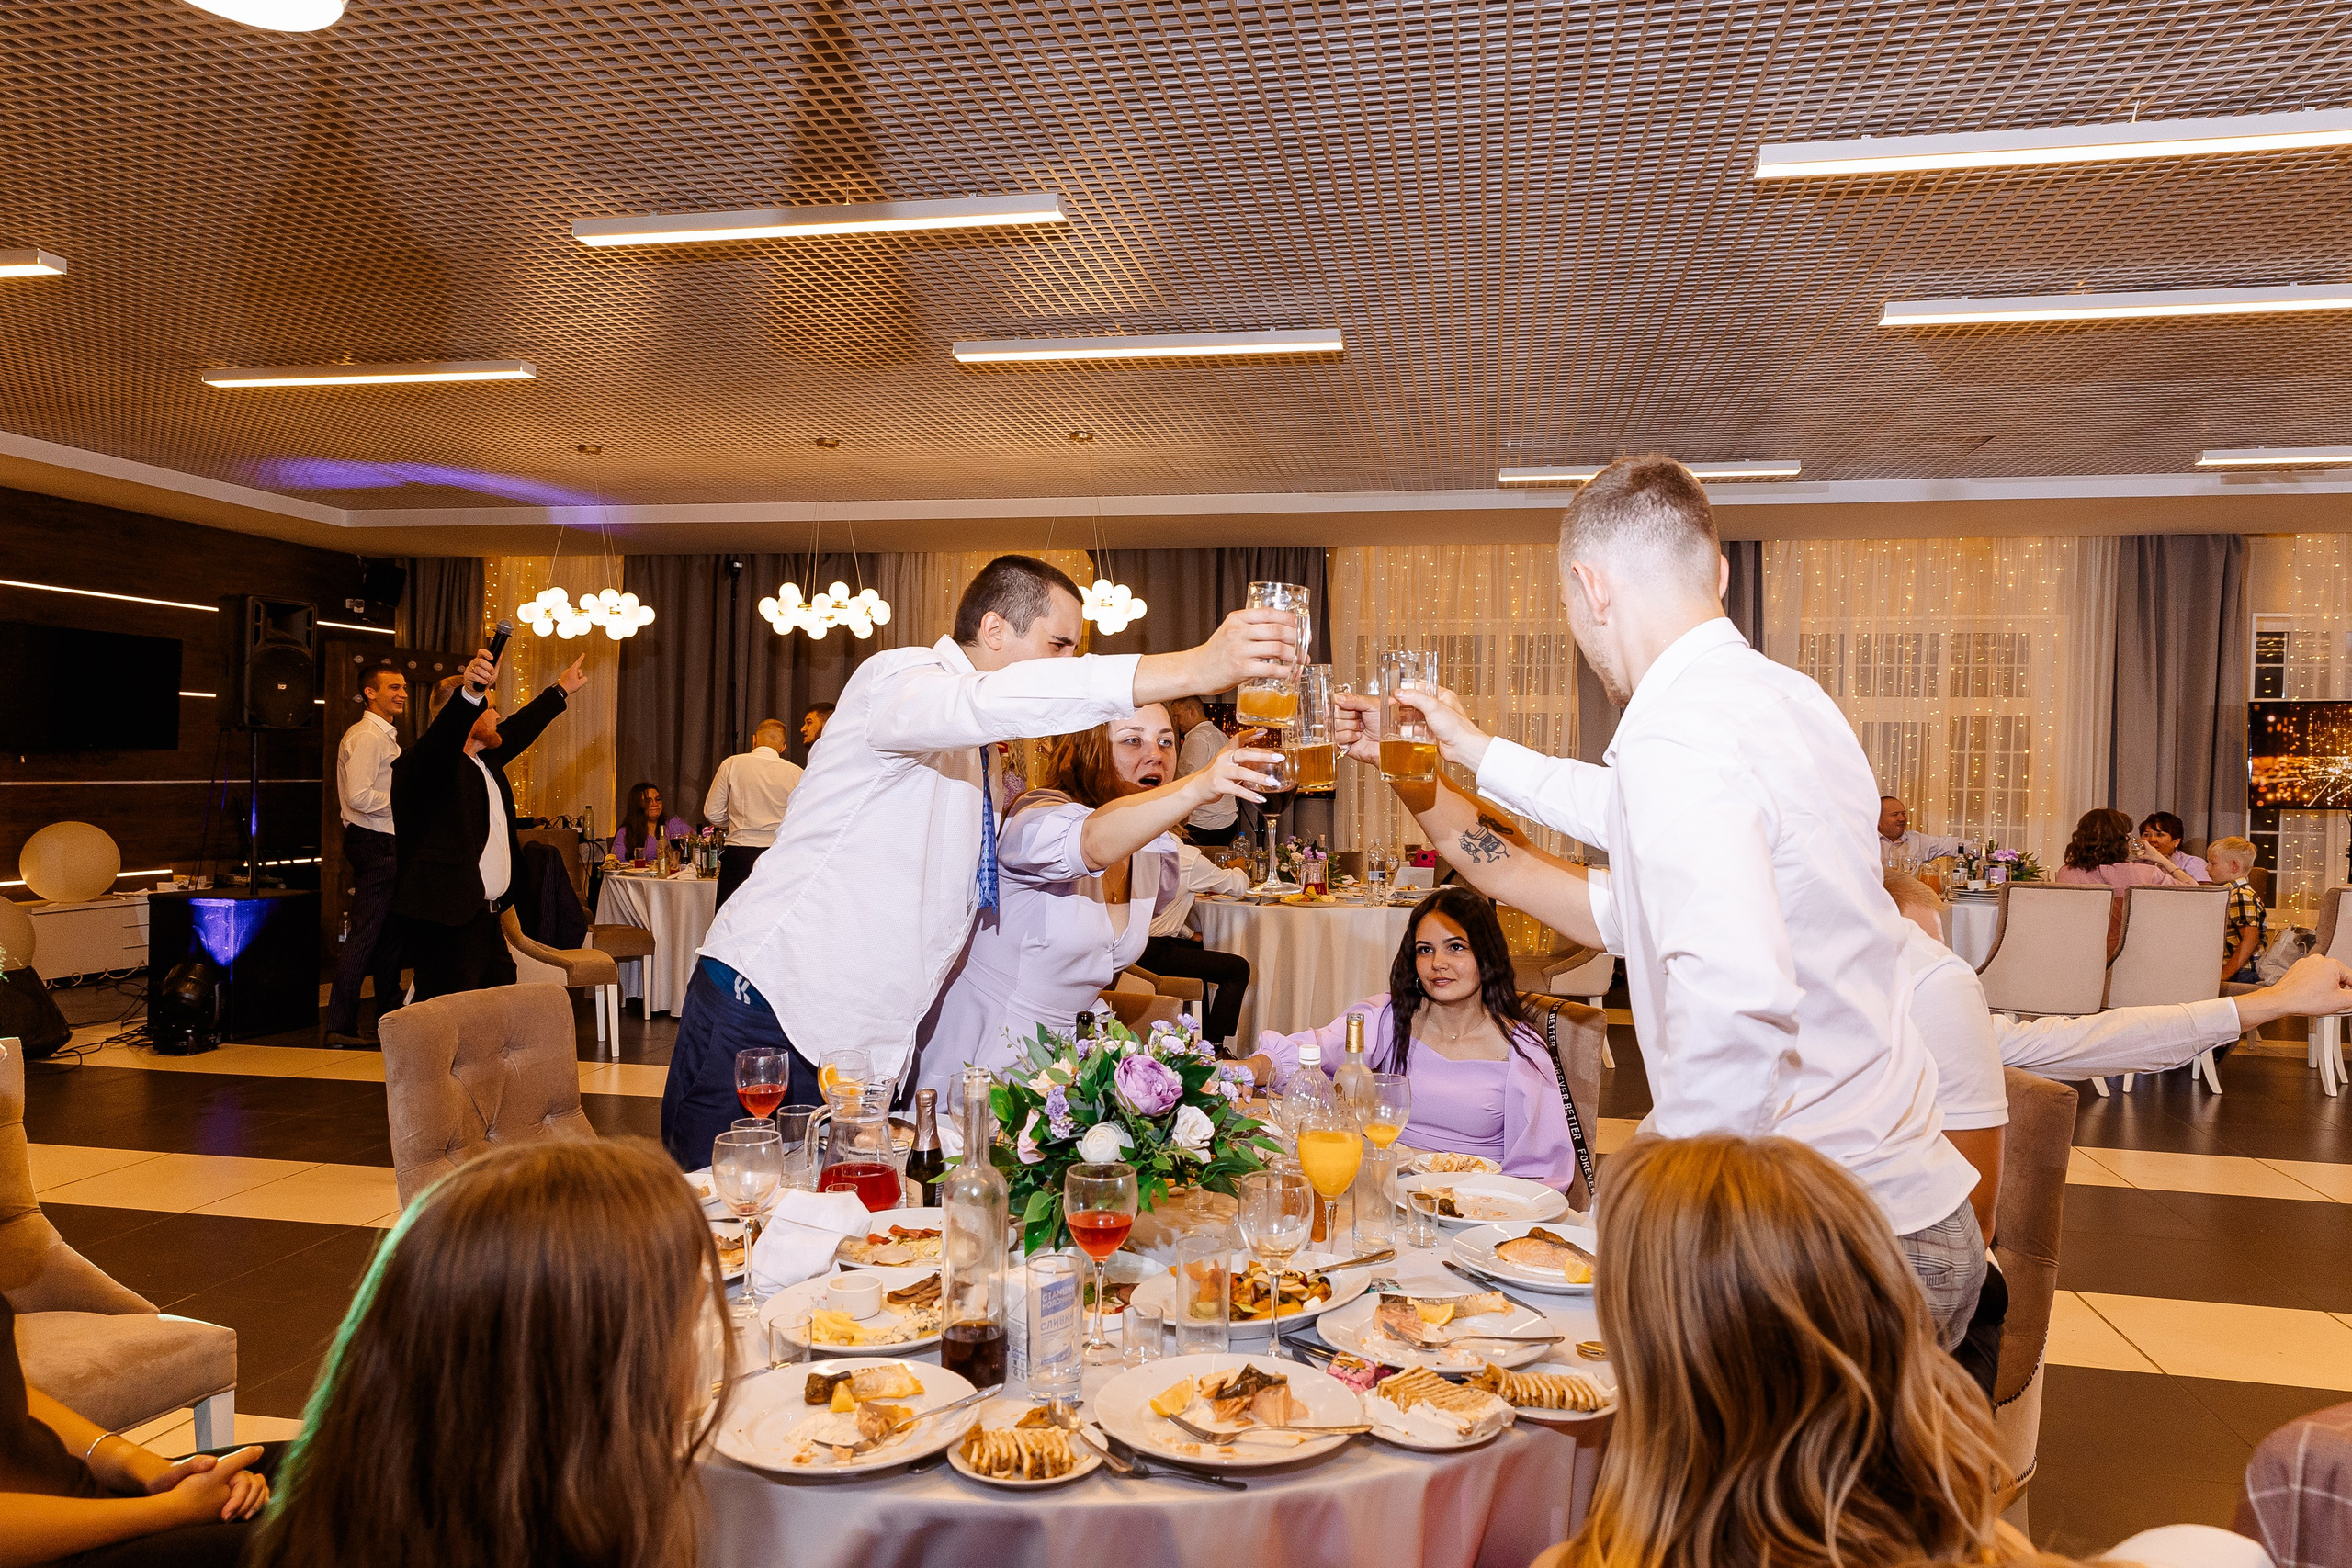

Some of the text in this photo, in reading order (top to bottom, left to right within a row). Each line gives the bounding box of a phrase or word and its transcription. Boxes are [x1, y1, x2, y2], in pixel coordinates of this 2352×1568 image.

[1548, 1012, 1595, 1193] BETTER FOREVER BETTER FOREVER
